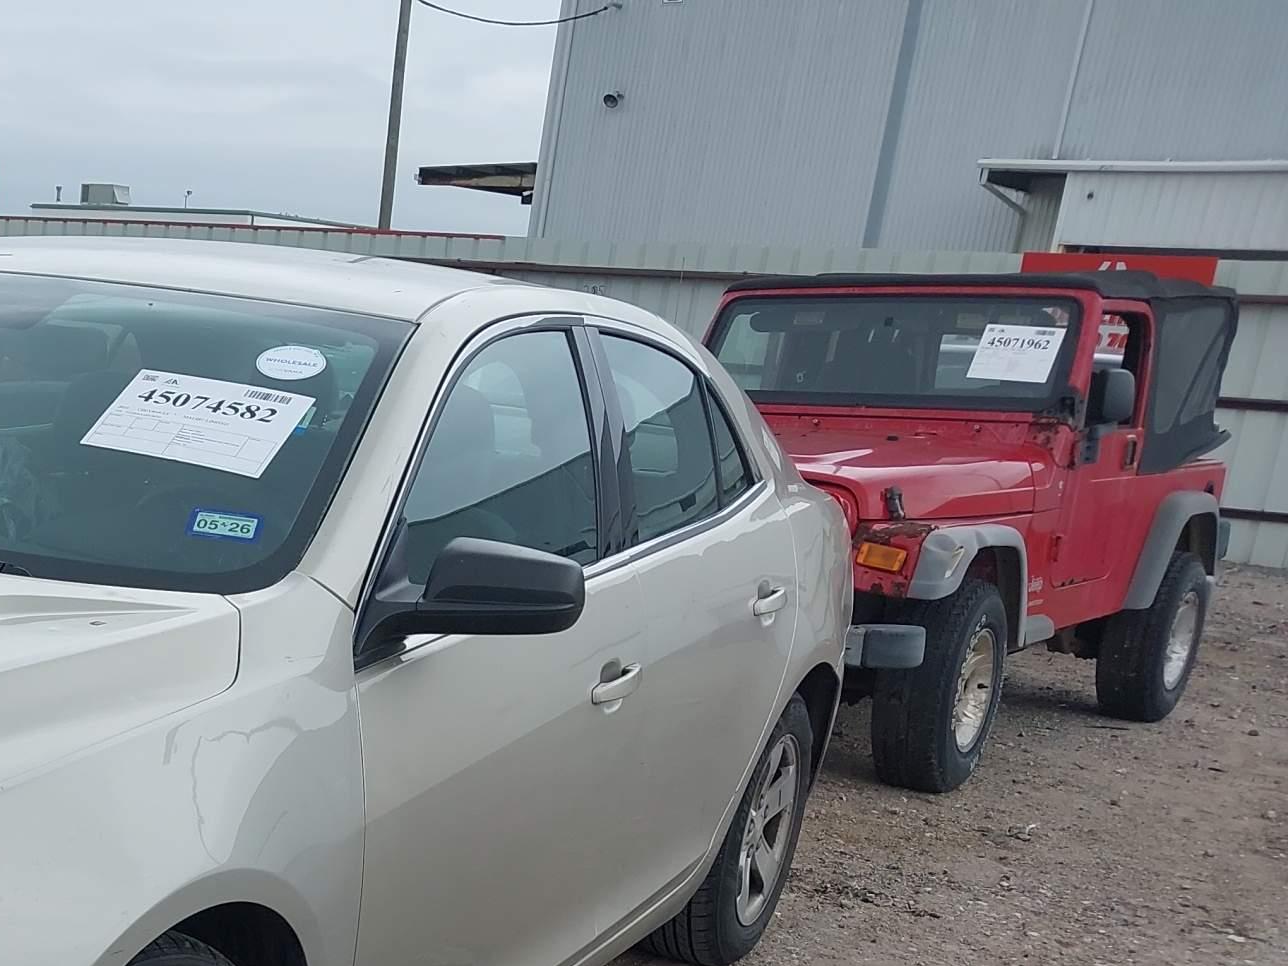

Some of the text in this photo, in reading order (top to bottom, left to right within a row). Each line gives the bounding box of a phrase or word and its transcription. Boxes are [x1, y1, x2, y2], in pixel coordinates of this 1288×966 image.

[987, 336, 1051, 351] 45071962
[266, 356, 319, 368] WHOLESALE
[137, 388, 278, 423] 45074582
